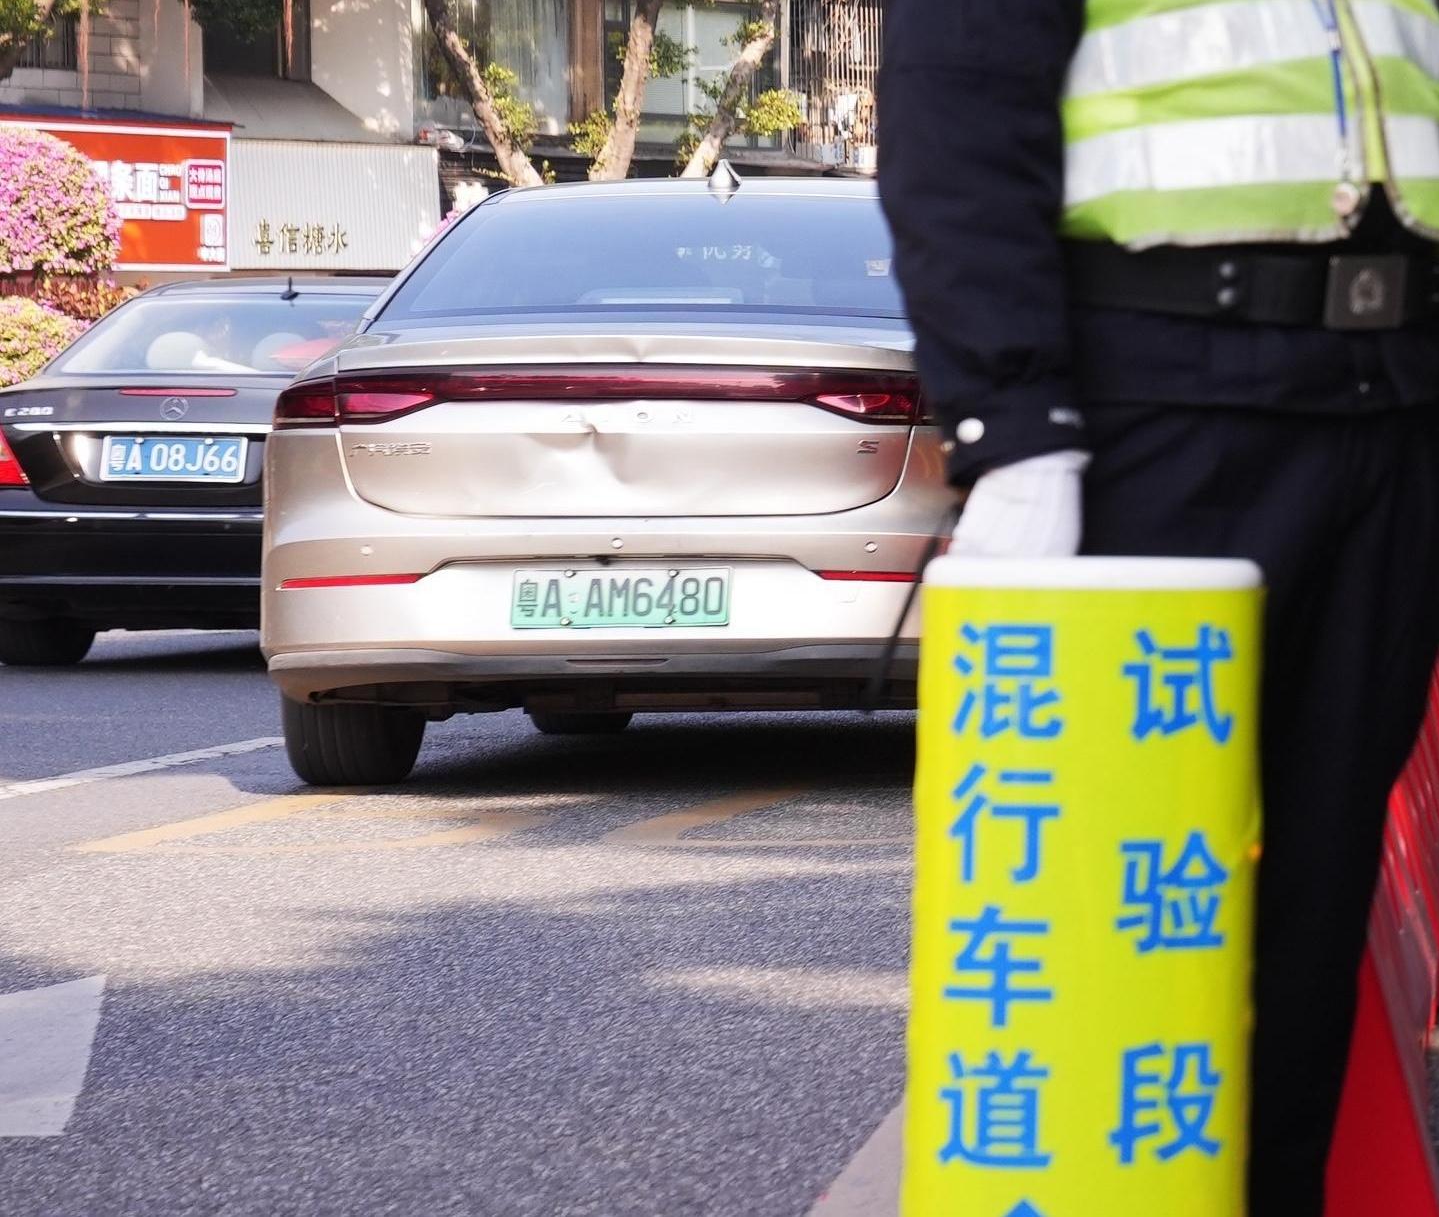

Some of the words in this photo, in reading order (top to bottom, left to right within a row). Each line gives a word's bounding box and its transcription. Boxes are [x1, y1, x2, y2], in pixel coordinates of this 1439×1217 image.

[937, 623, 1066, 1217] 混行车道
[1108, 623, 1236, 1169] 试验段
